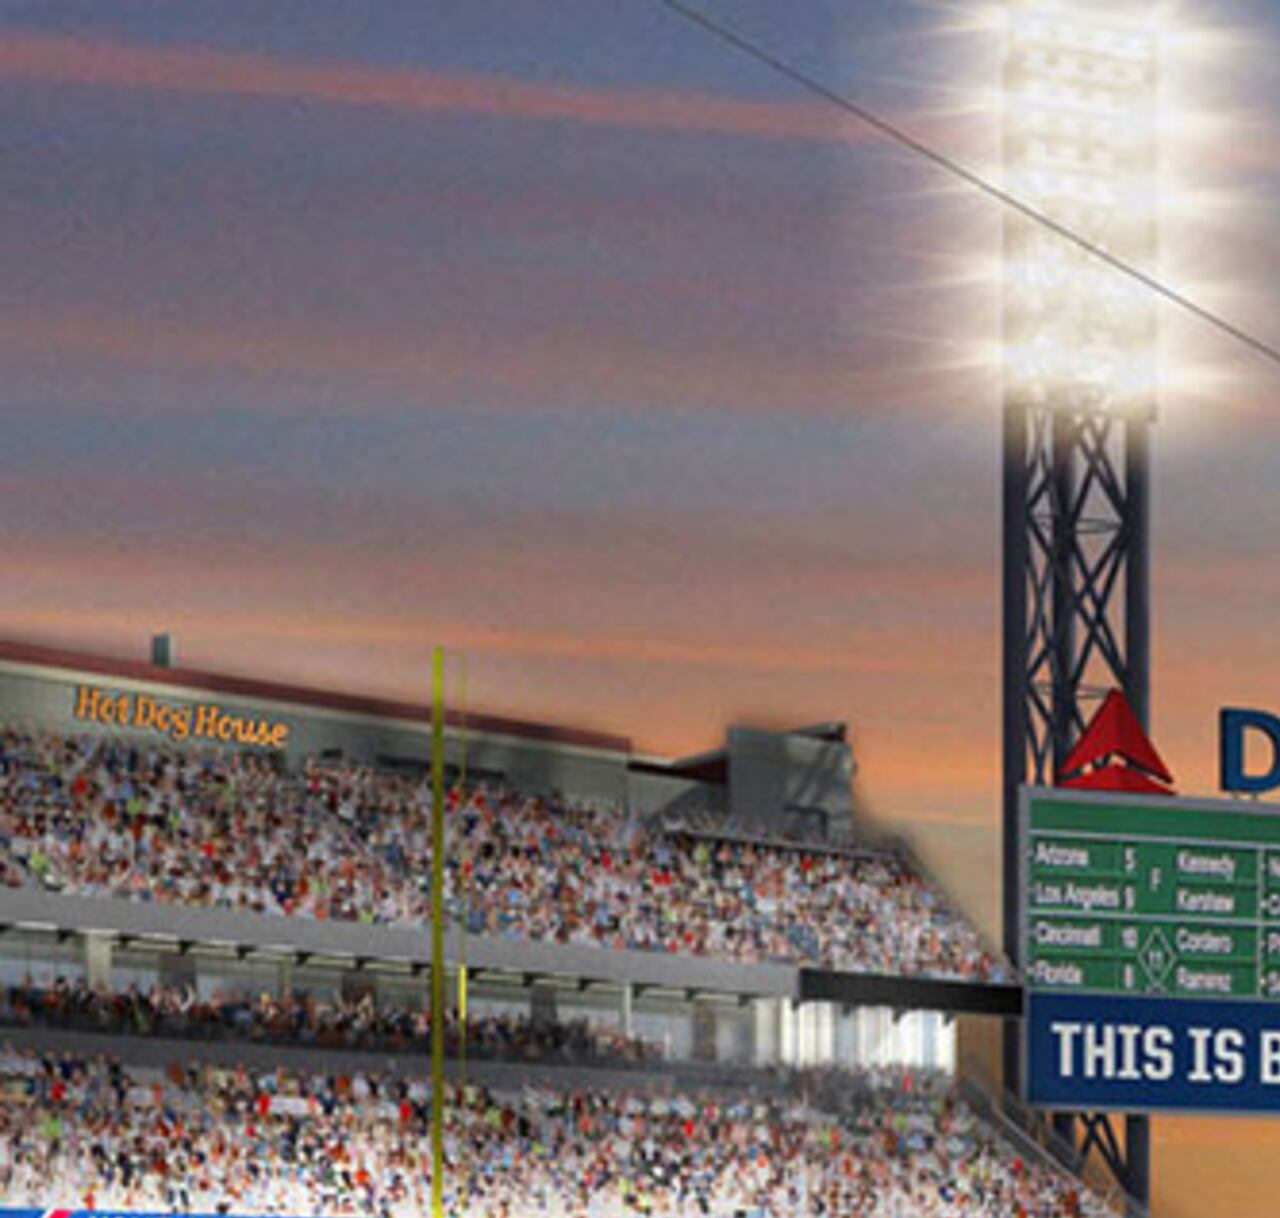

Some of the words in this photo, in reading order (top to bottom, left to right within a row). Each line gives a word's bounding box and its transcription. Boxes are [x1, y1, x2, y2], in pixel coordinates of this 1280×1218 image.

[76, 684, 130, 726] Hot
[134, 692, 190, 740] Dog
[195, 704, 290, 747] House
[1035, 883, 1062, 904] Los
[1064, 883, 1119, 910] Angeles
[1051, 1021, 1174, 1081] THIS
[1187, 1026, 1245, 1084] IS
